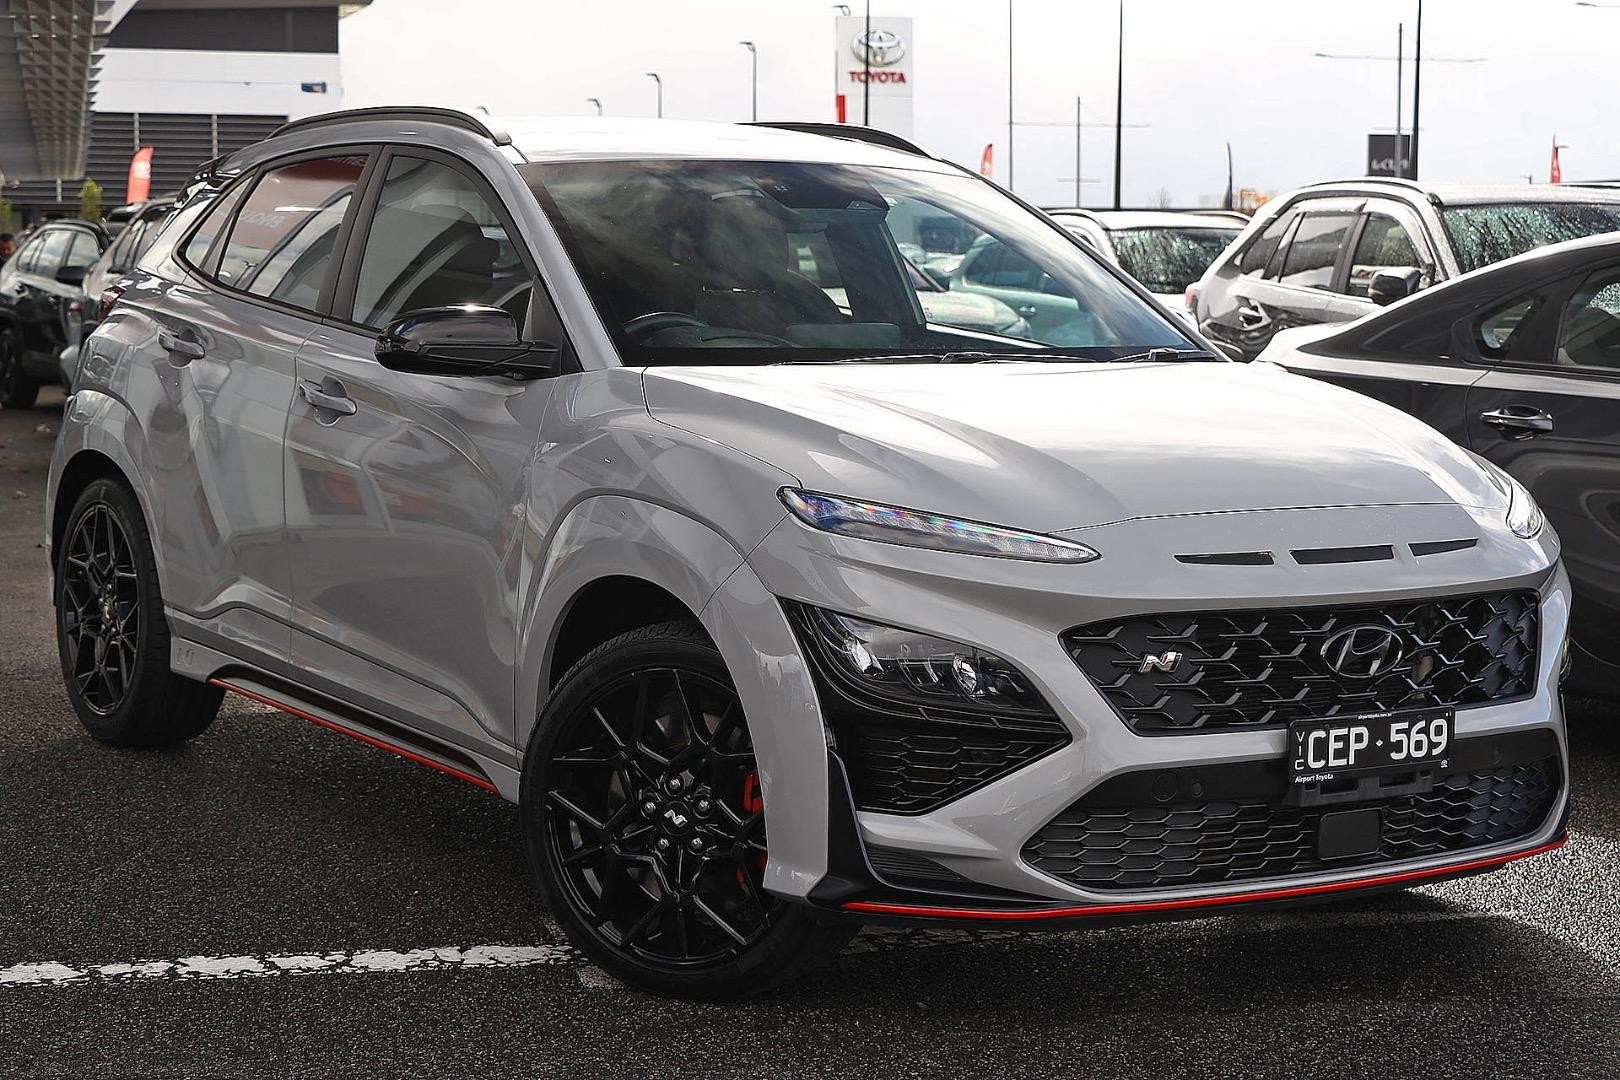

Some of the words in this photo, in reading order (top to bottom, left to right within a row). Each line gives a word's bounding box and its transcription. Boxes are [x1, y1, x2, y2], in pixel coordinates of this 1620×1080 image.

[849, 71, 906, 83] TOYOTA
[1295, 731, 1305, 770] VIC
[1307, 727, 1369, 769] CEP
[1390, 718, 1448, 761] 569
[1295, 774, 1315, 784] Airport
[1315, 773, 1334, 782] Toyota
